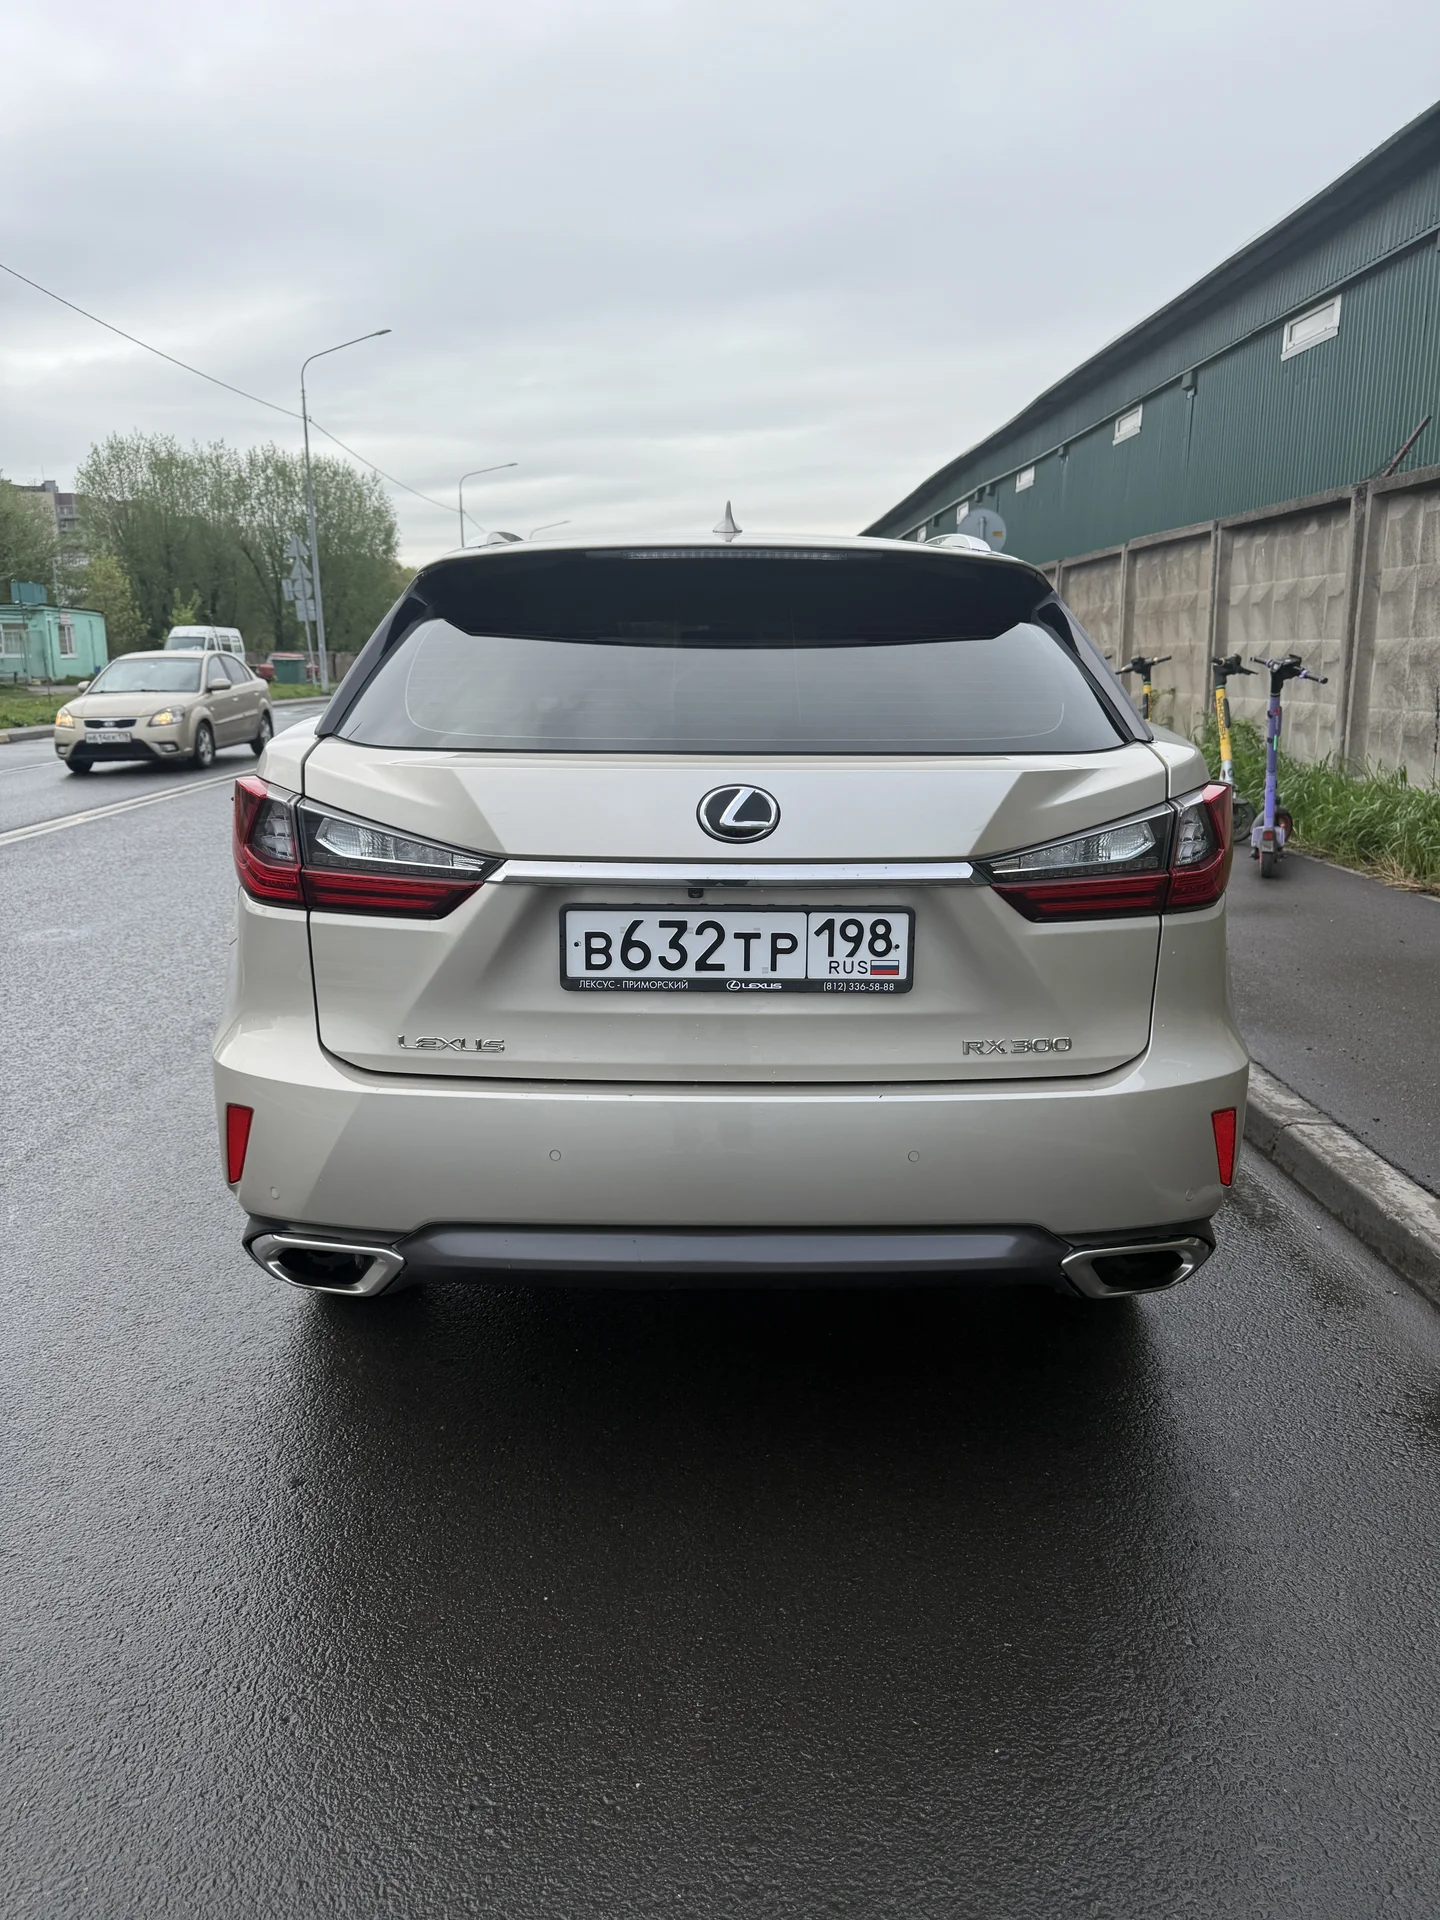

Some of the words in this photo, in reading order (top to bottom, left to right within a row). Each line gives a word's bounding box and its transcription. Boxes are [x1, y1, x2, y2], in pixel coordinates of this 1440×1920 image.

[584, 919, 799, 972] В632ТР
[813, 918, 893, 958] 198
[828, 960, 868, 975] RUS
[579, 979, 615, 989] ЛЕКСУС
[622, 979, 689, 989] ПРИМОРСКИЙ
[742, 982, 782, 990] LEXUS
[823, 982, 846, 991] (812)
[848, 982, 895, 991] 336-58-88
[398, 1035, 505, 1053] LEXUS
[962, 1039, 1007, 1055] RX
[1011, 1036, 1072, 1053] 300
